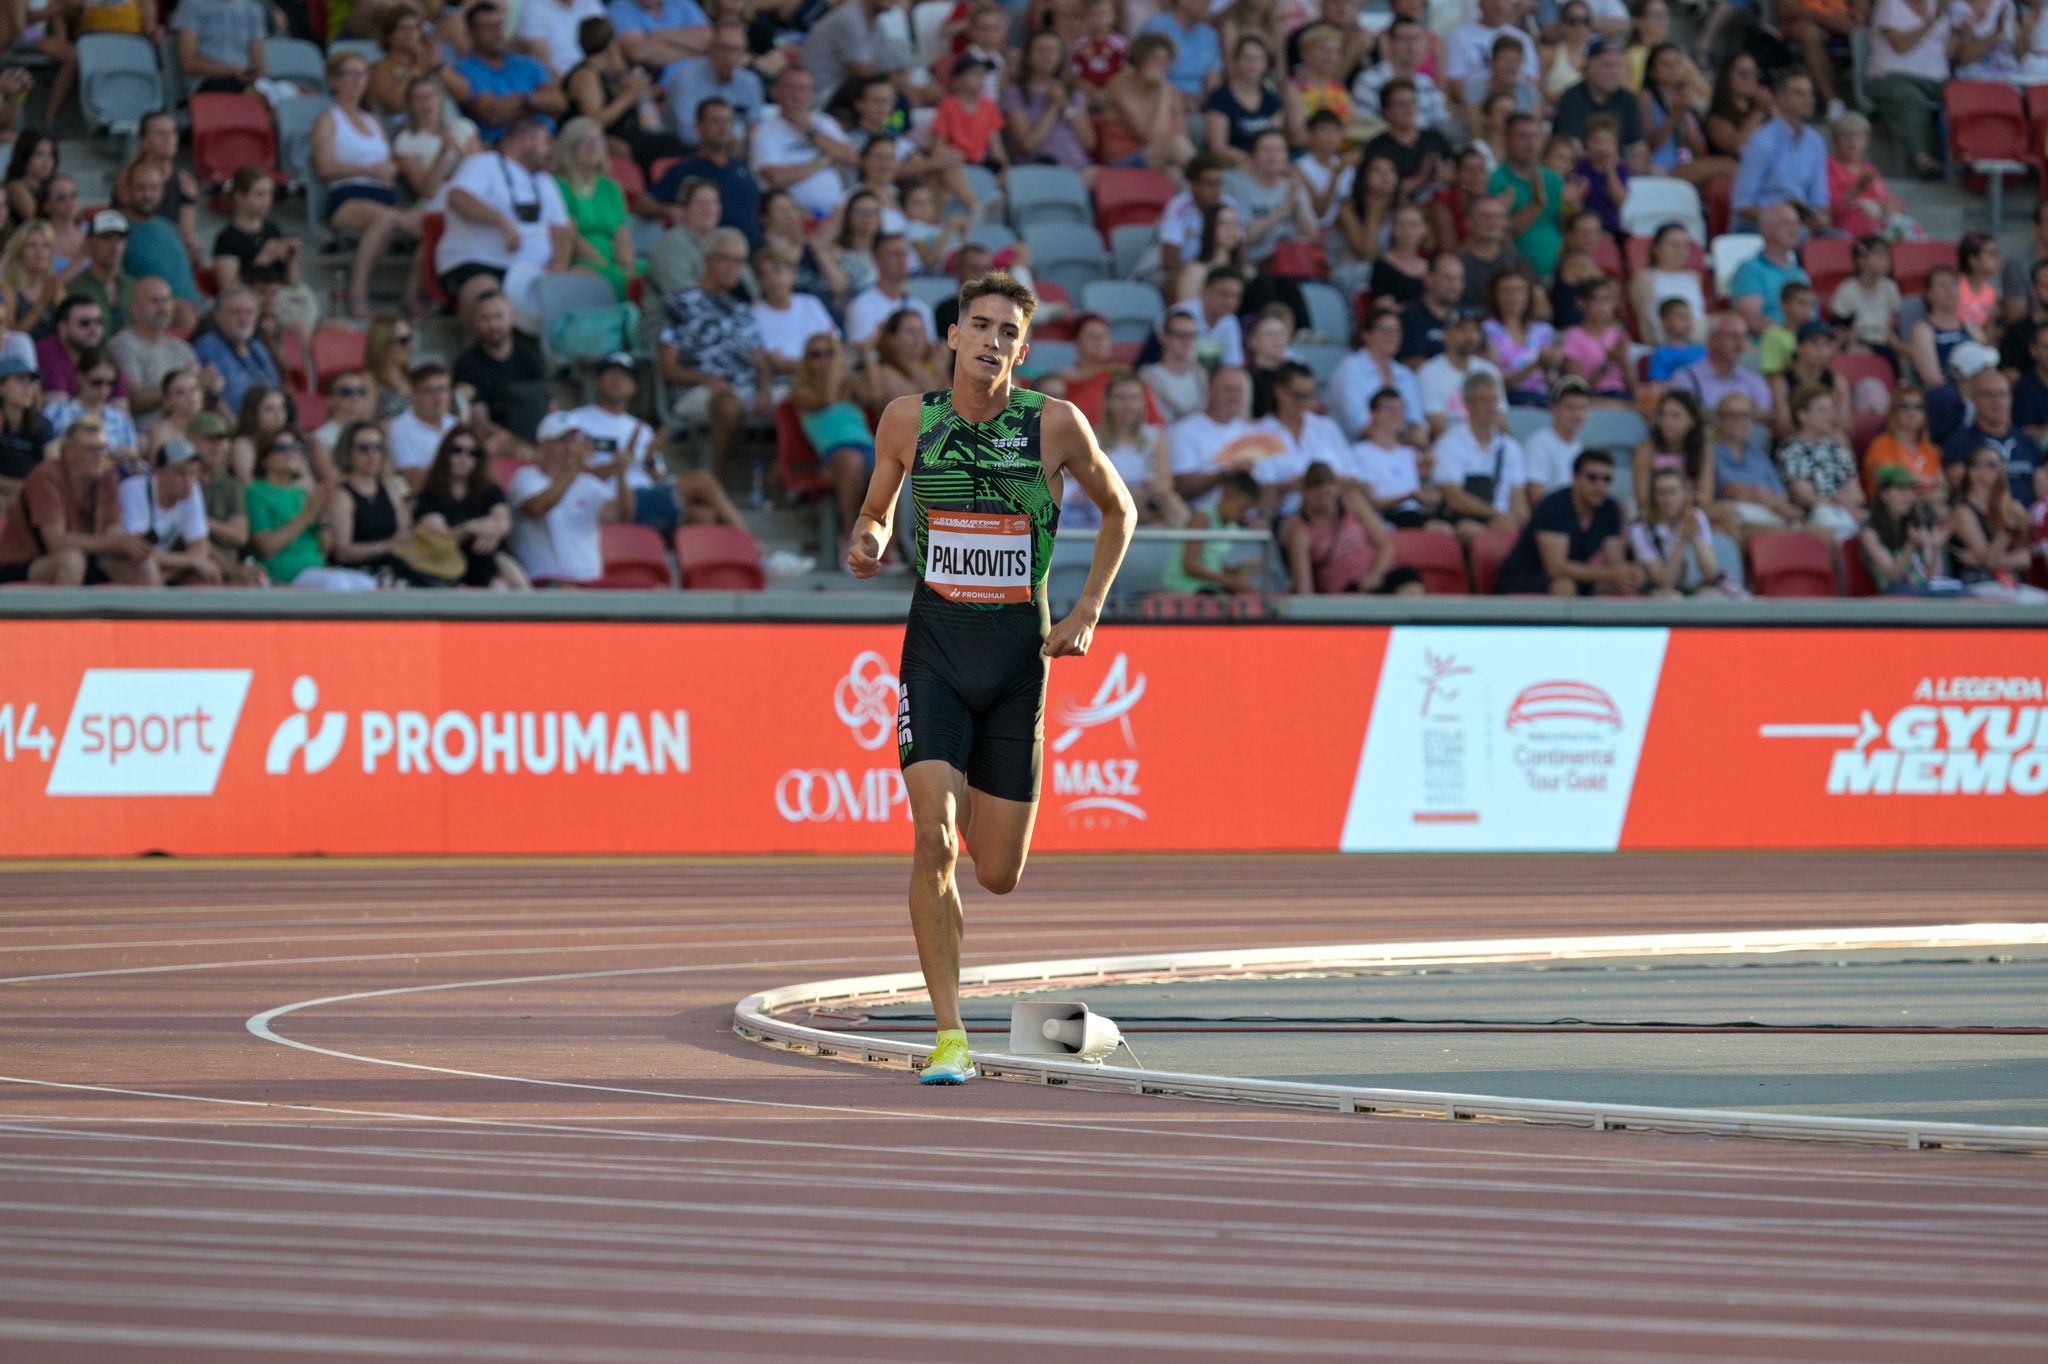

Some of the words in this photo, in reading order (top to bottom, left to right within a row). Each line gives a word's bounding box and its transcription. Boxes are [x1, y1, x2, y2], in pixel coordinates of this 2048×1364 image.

[932, 545, 1027, 577] PALKOVITS
[962, 591, 1005, 599] PROHUMAN
[81, 706, 214, 766] sport
[361, 709, 690, 775] PROHUMAN
[1053, 758, 1141, 795] MASZ
